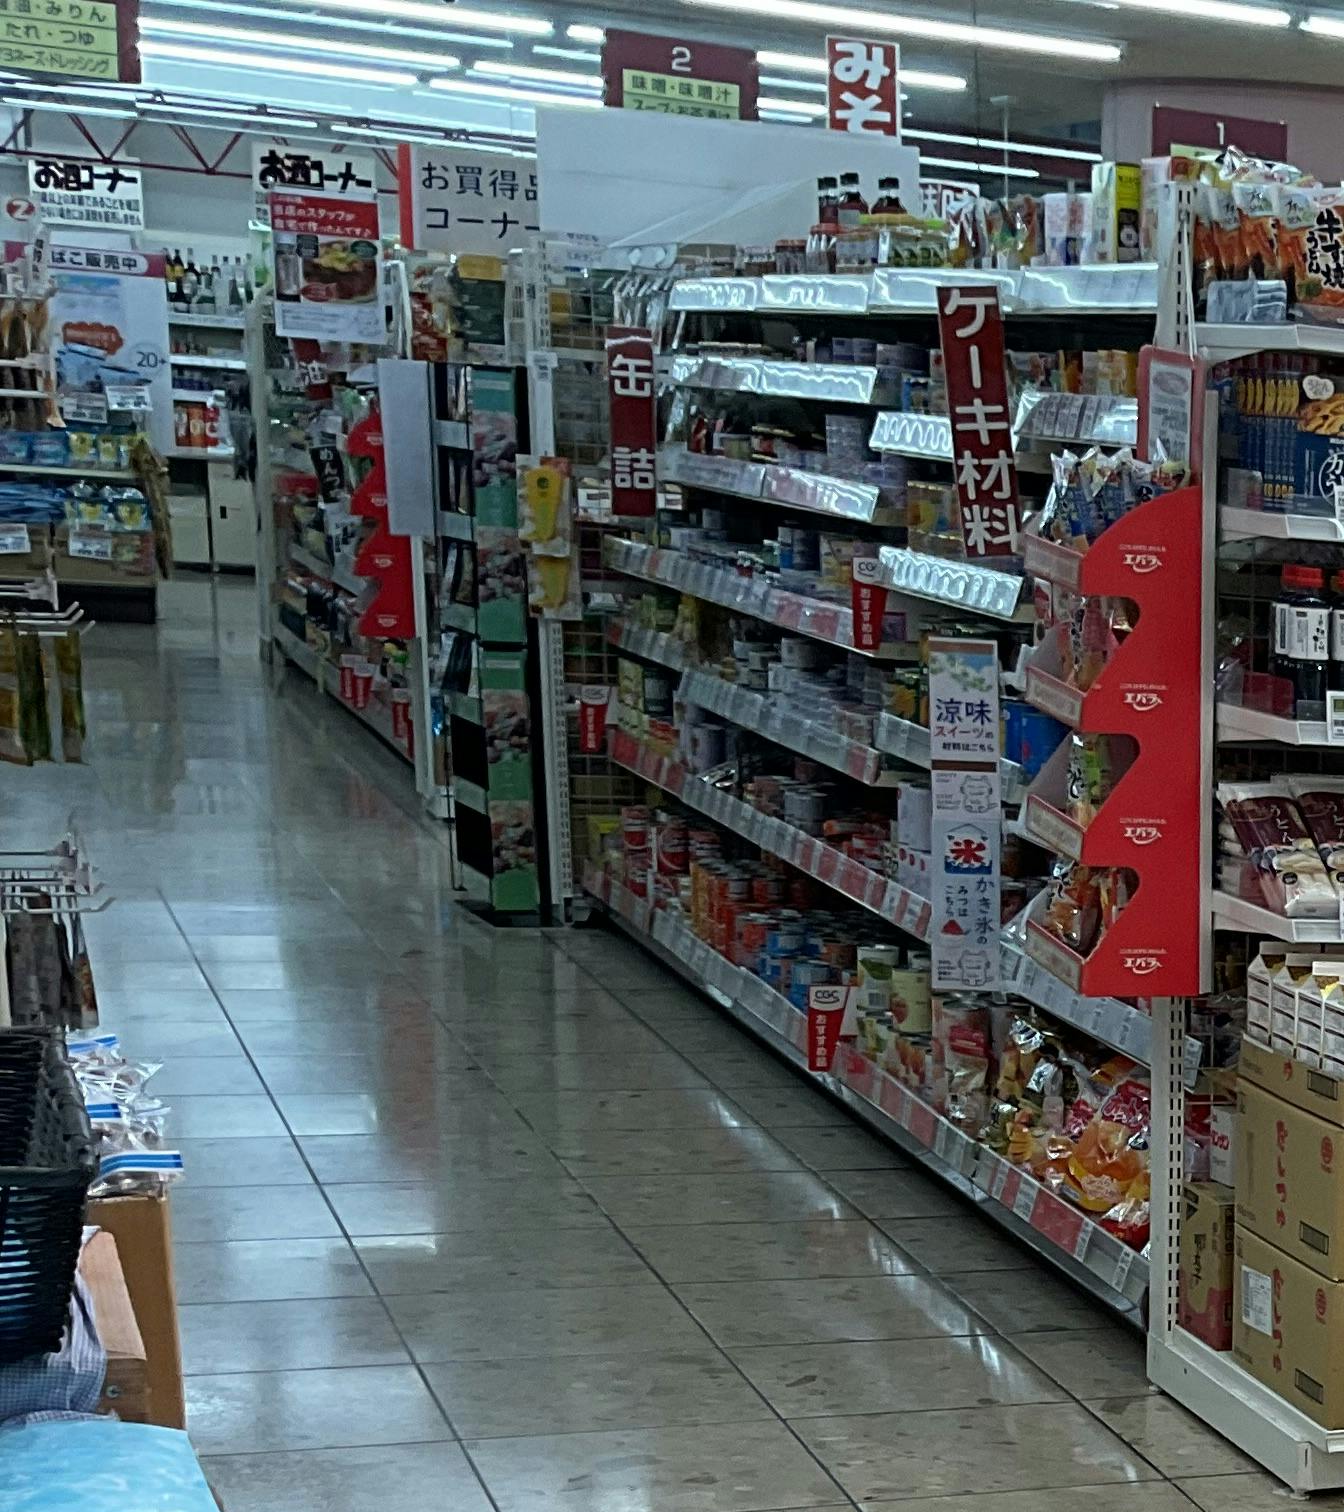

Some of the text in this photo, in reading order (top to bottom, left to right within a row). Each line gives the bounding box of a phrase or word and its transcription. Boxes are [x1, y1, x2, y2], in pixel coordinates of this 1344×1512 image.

[5, 22, 95, 46] たれ・つゆ
[671, 46, 692, 72] 2
[833, 42, 892, 136] みそ
[1216, 121, 1225, 145] 1
[426, 206, 541, 239] コーナー
[611, 353, 656, 490] 缶詰
[943, 288, 1020, 555] ケーキ材料
[935, 697, 993, 725] 涼味
